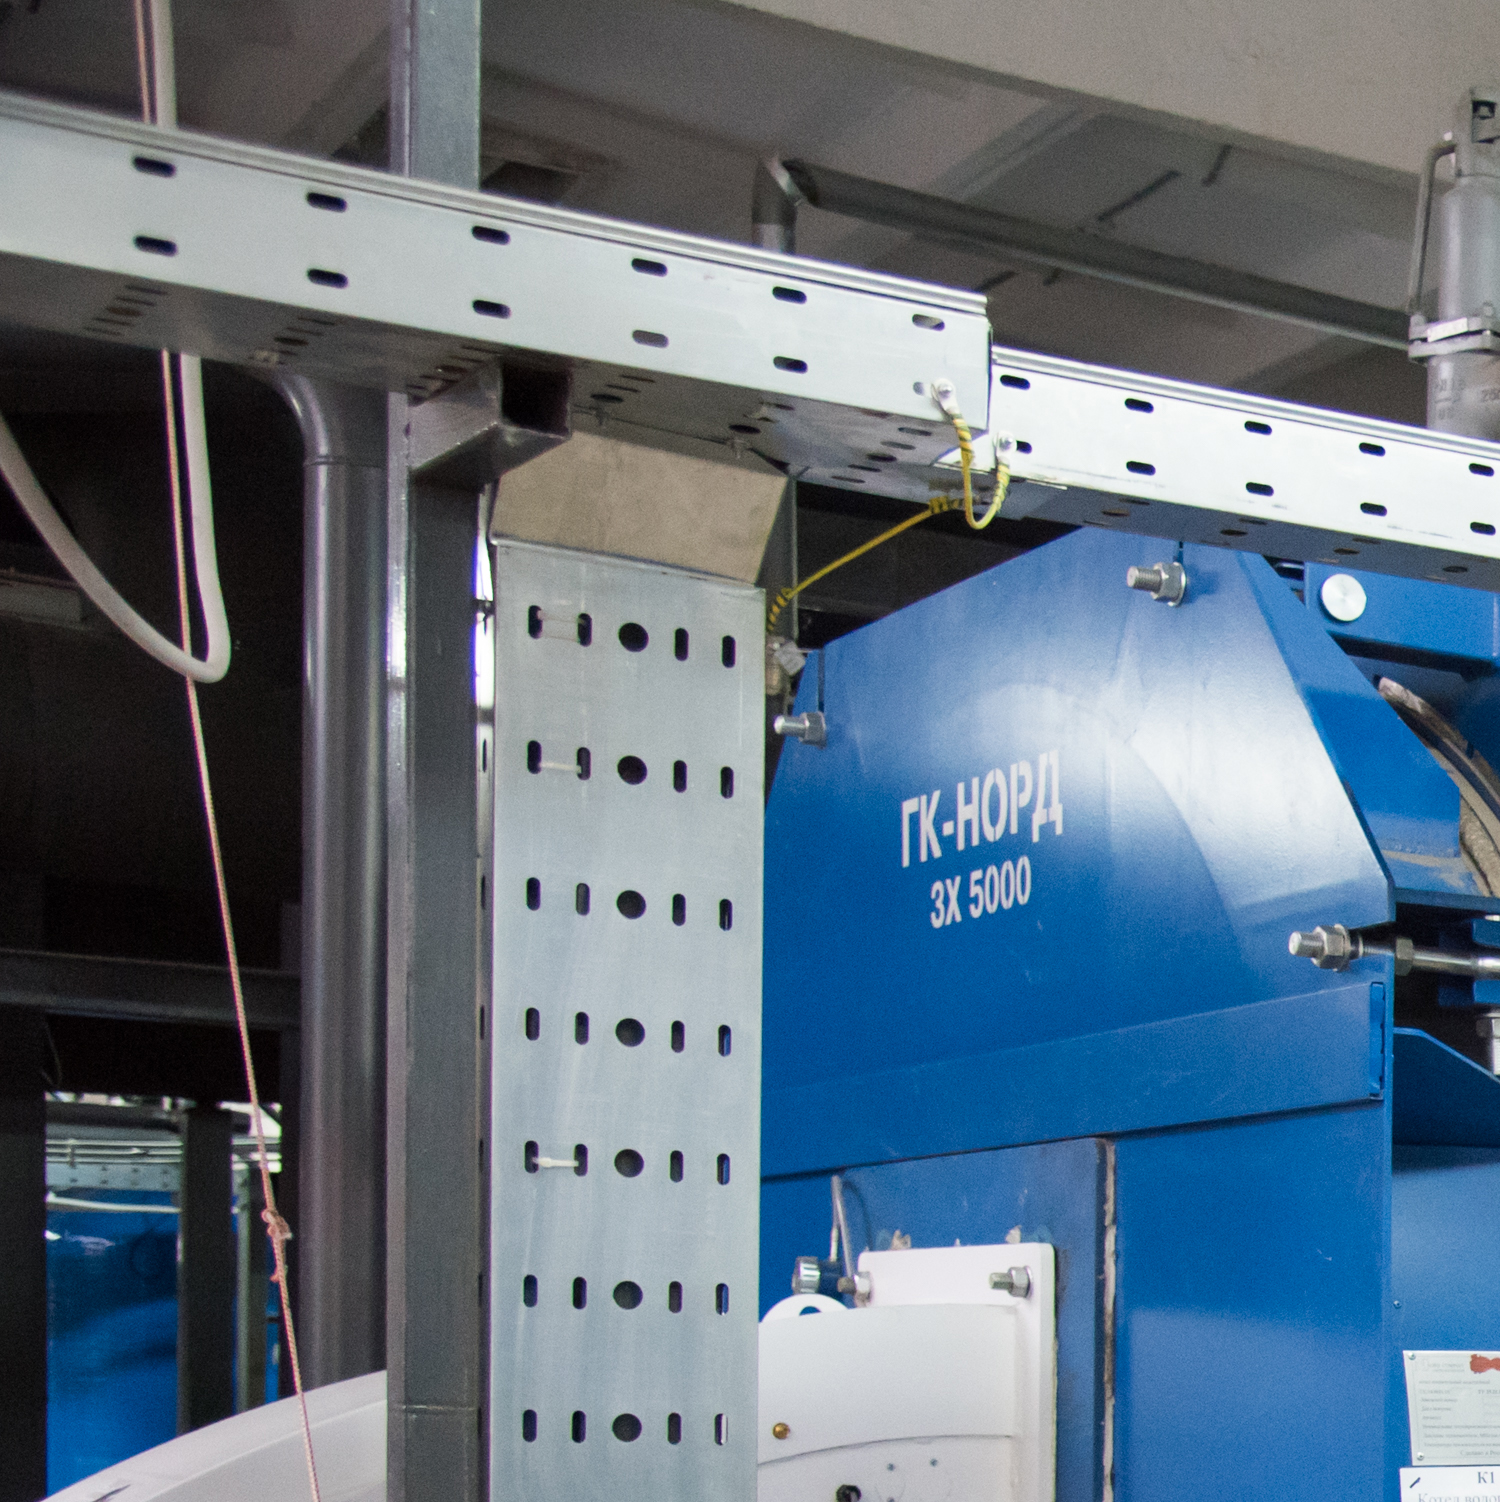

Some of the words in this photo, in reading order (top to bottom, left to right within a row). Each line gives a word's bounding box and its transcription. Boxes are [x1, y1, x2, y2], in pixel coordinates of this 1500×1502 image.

[901, 750, 1063, 868] ГК-НОРД
[969, 855, 1032, 919] 5000
[1477, 1471, 1495, 1484] К1
